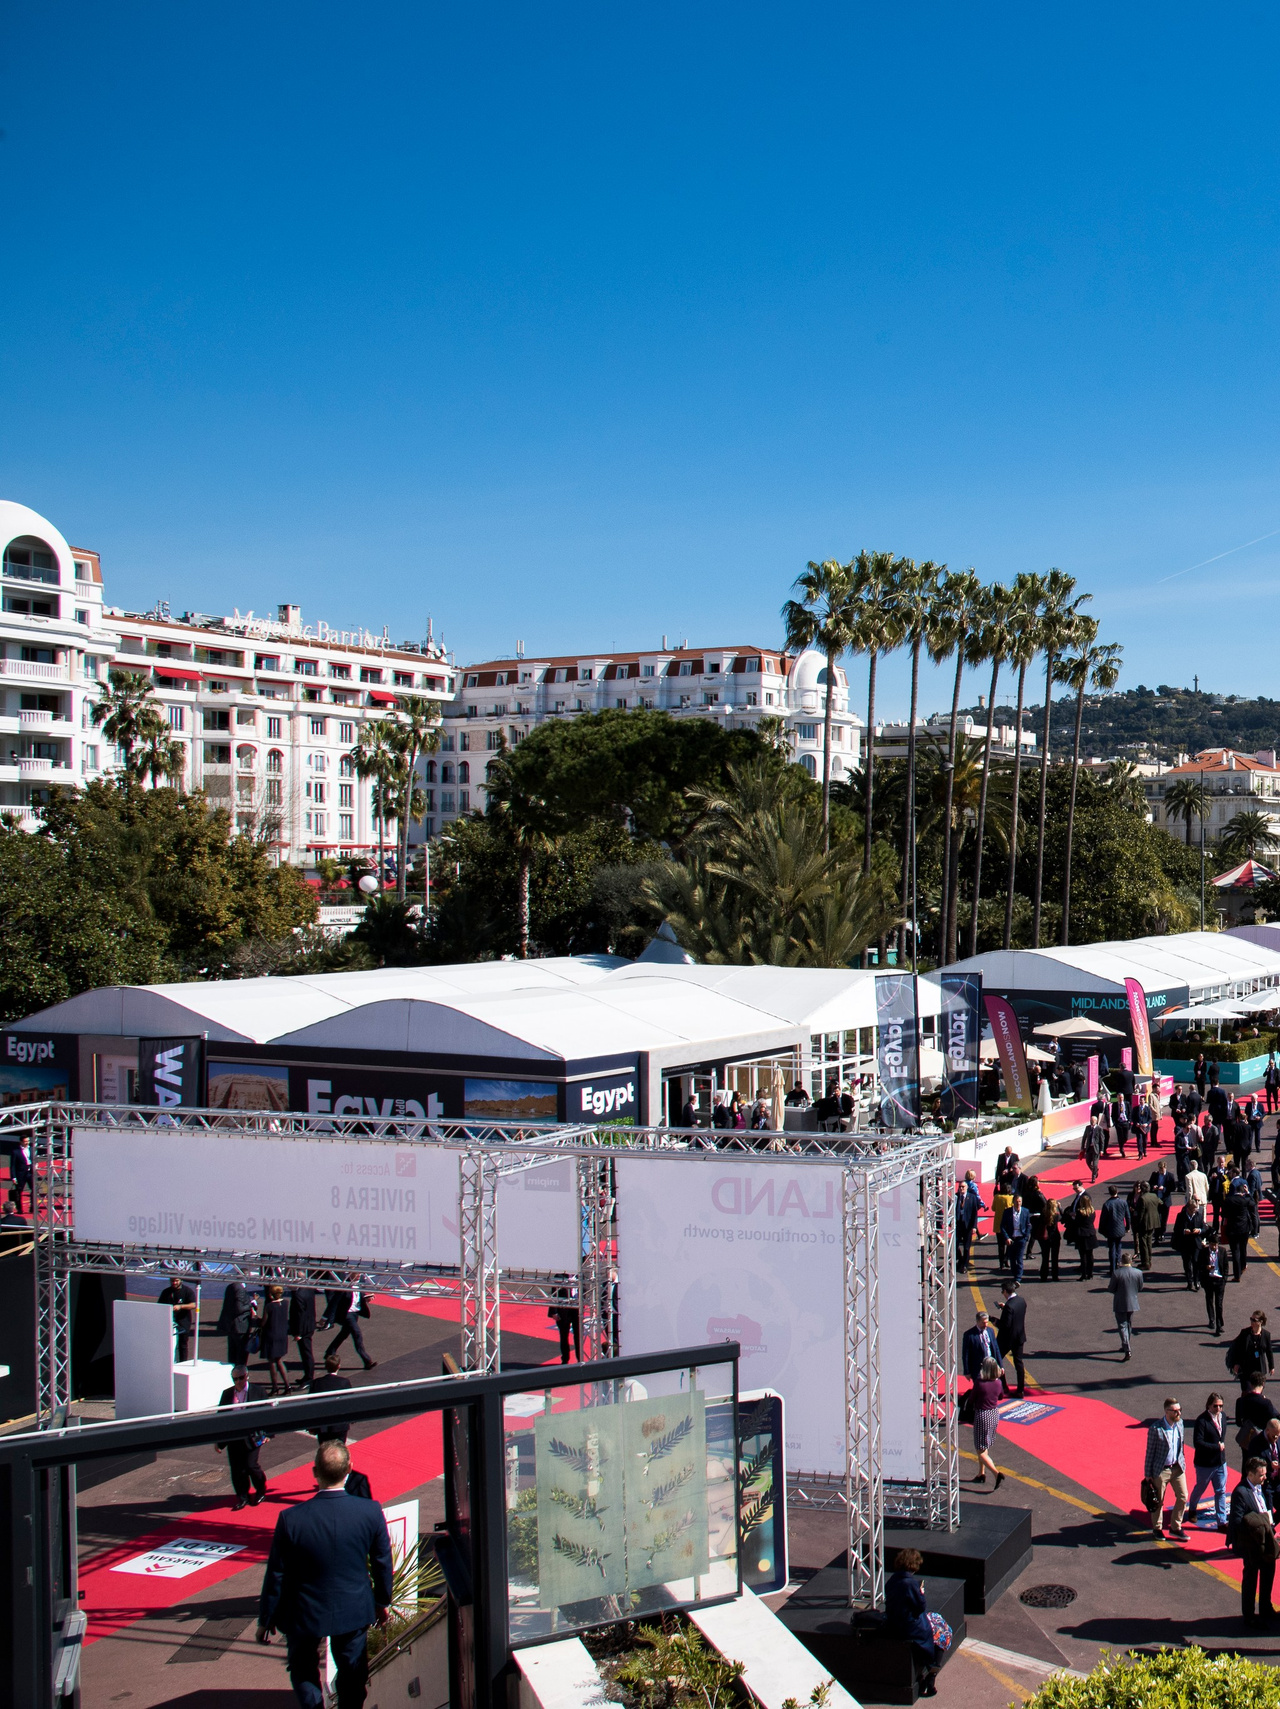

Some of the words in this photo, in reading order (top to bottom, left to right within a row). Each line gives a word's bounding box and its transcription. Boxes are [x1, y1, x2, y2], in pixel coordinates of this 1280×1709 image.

[231, 608, 312, 641] Majestic
[317, 620, 391, 651] Barrière
[1071, 997, 1130, 1010] MIDLANDS
[1146, 995, 1167, 1008] DLANDS
[7, 1036, 55, 1062] Egypt
[998, 1011, 1023, 1099] #SCOTLANDISNOW
[307, 1079, 444, 1137] Egypt
[581, 1082, 634, 1114] Egypt
[143, 1555, 205, 1566] WARSAW
